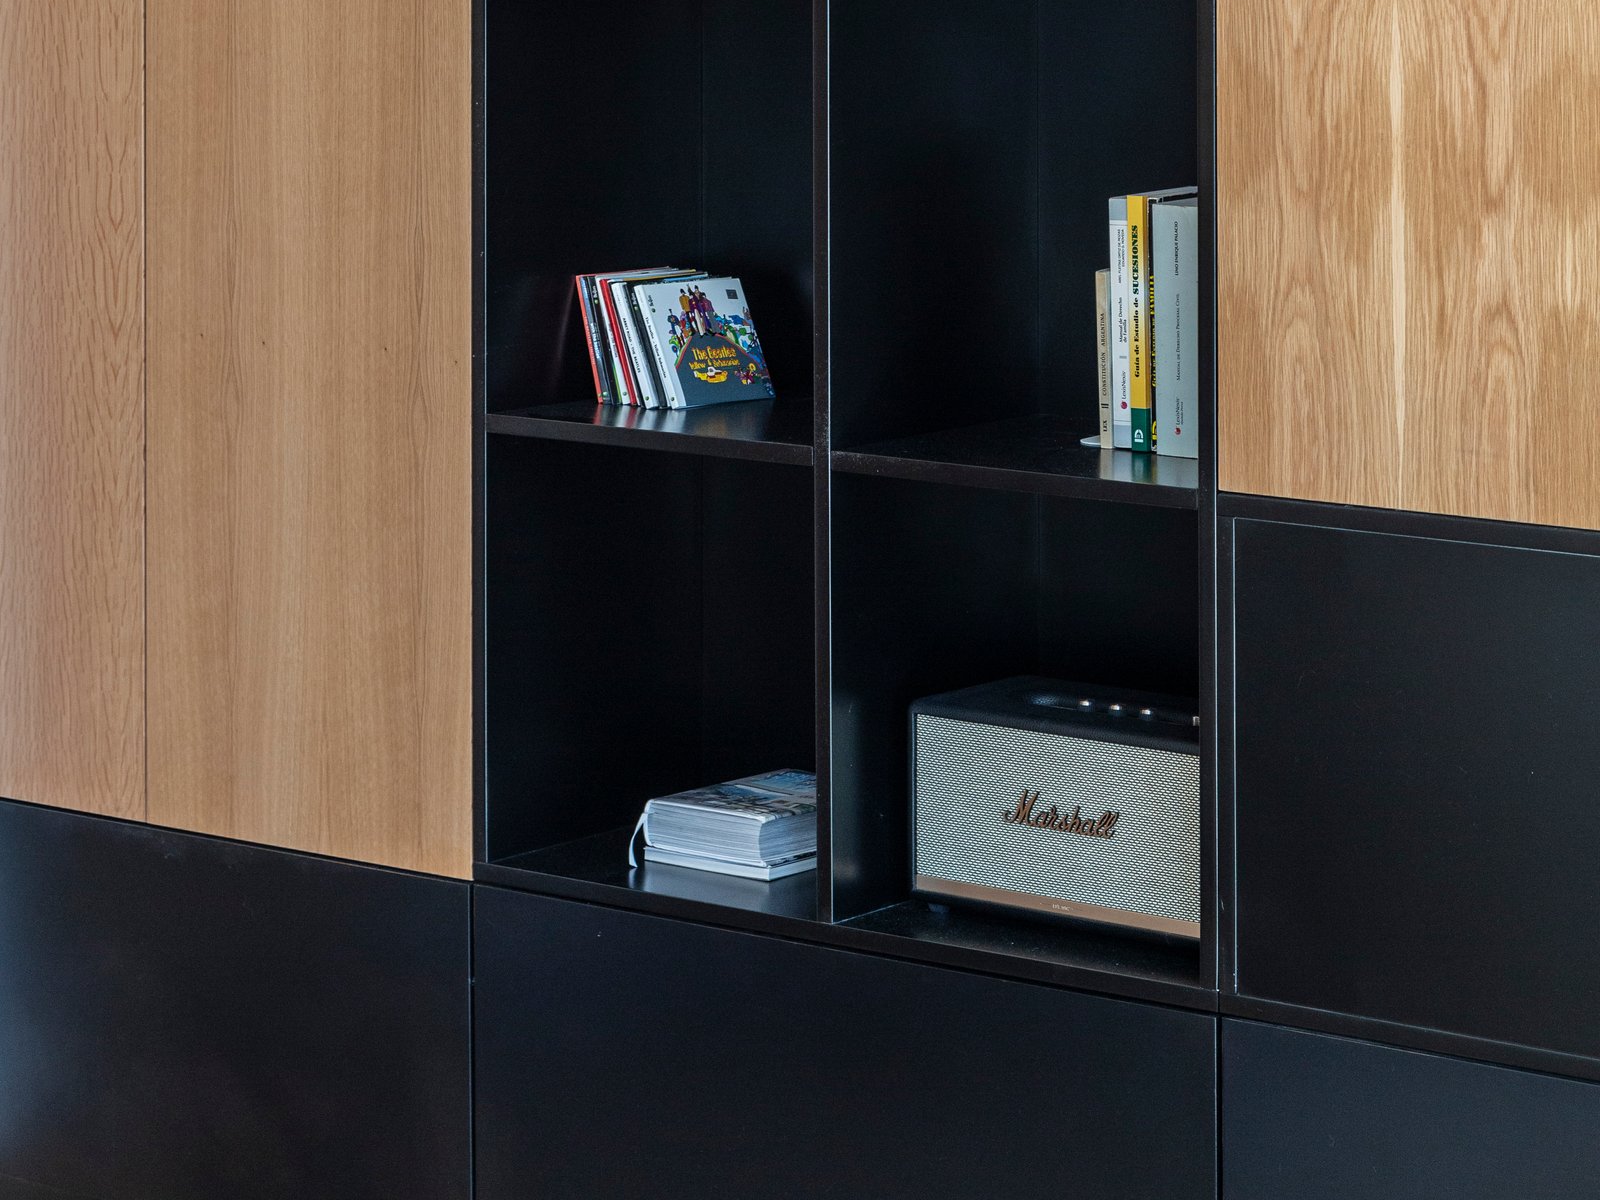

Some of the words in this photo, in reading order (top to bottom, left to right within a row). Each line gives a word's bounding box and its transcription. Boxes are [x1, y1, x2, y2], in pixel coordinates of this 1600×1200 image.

[1133, 297, 1139, 307] de
[691, 347, 708, 360] The
[706, 345, 737, 359] Beatles
[1134, 344, 1139, 355] de
[1003, 789, 1119, 839] Marshall
